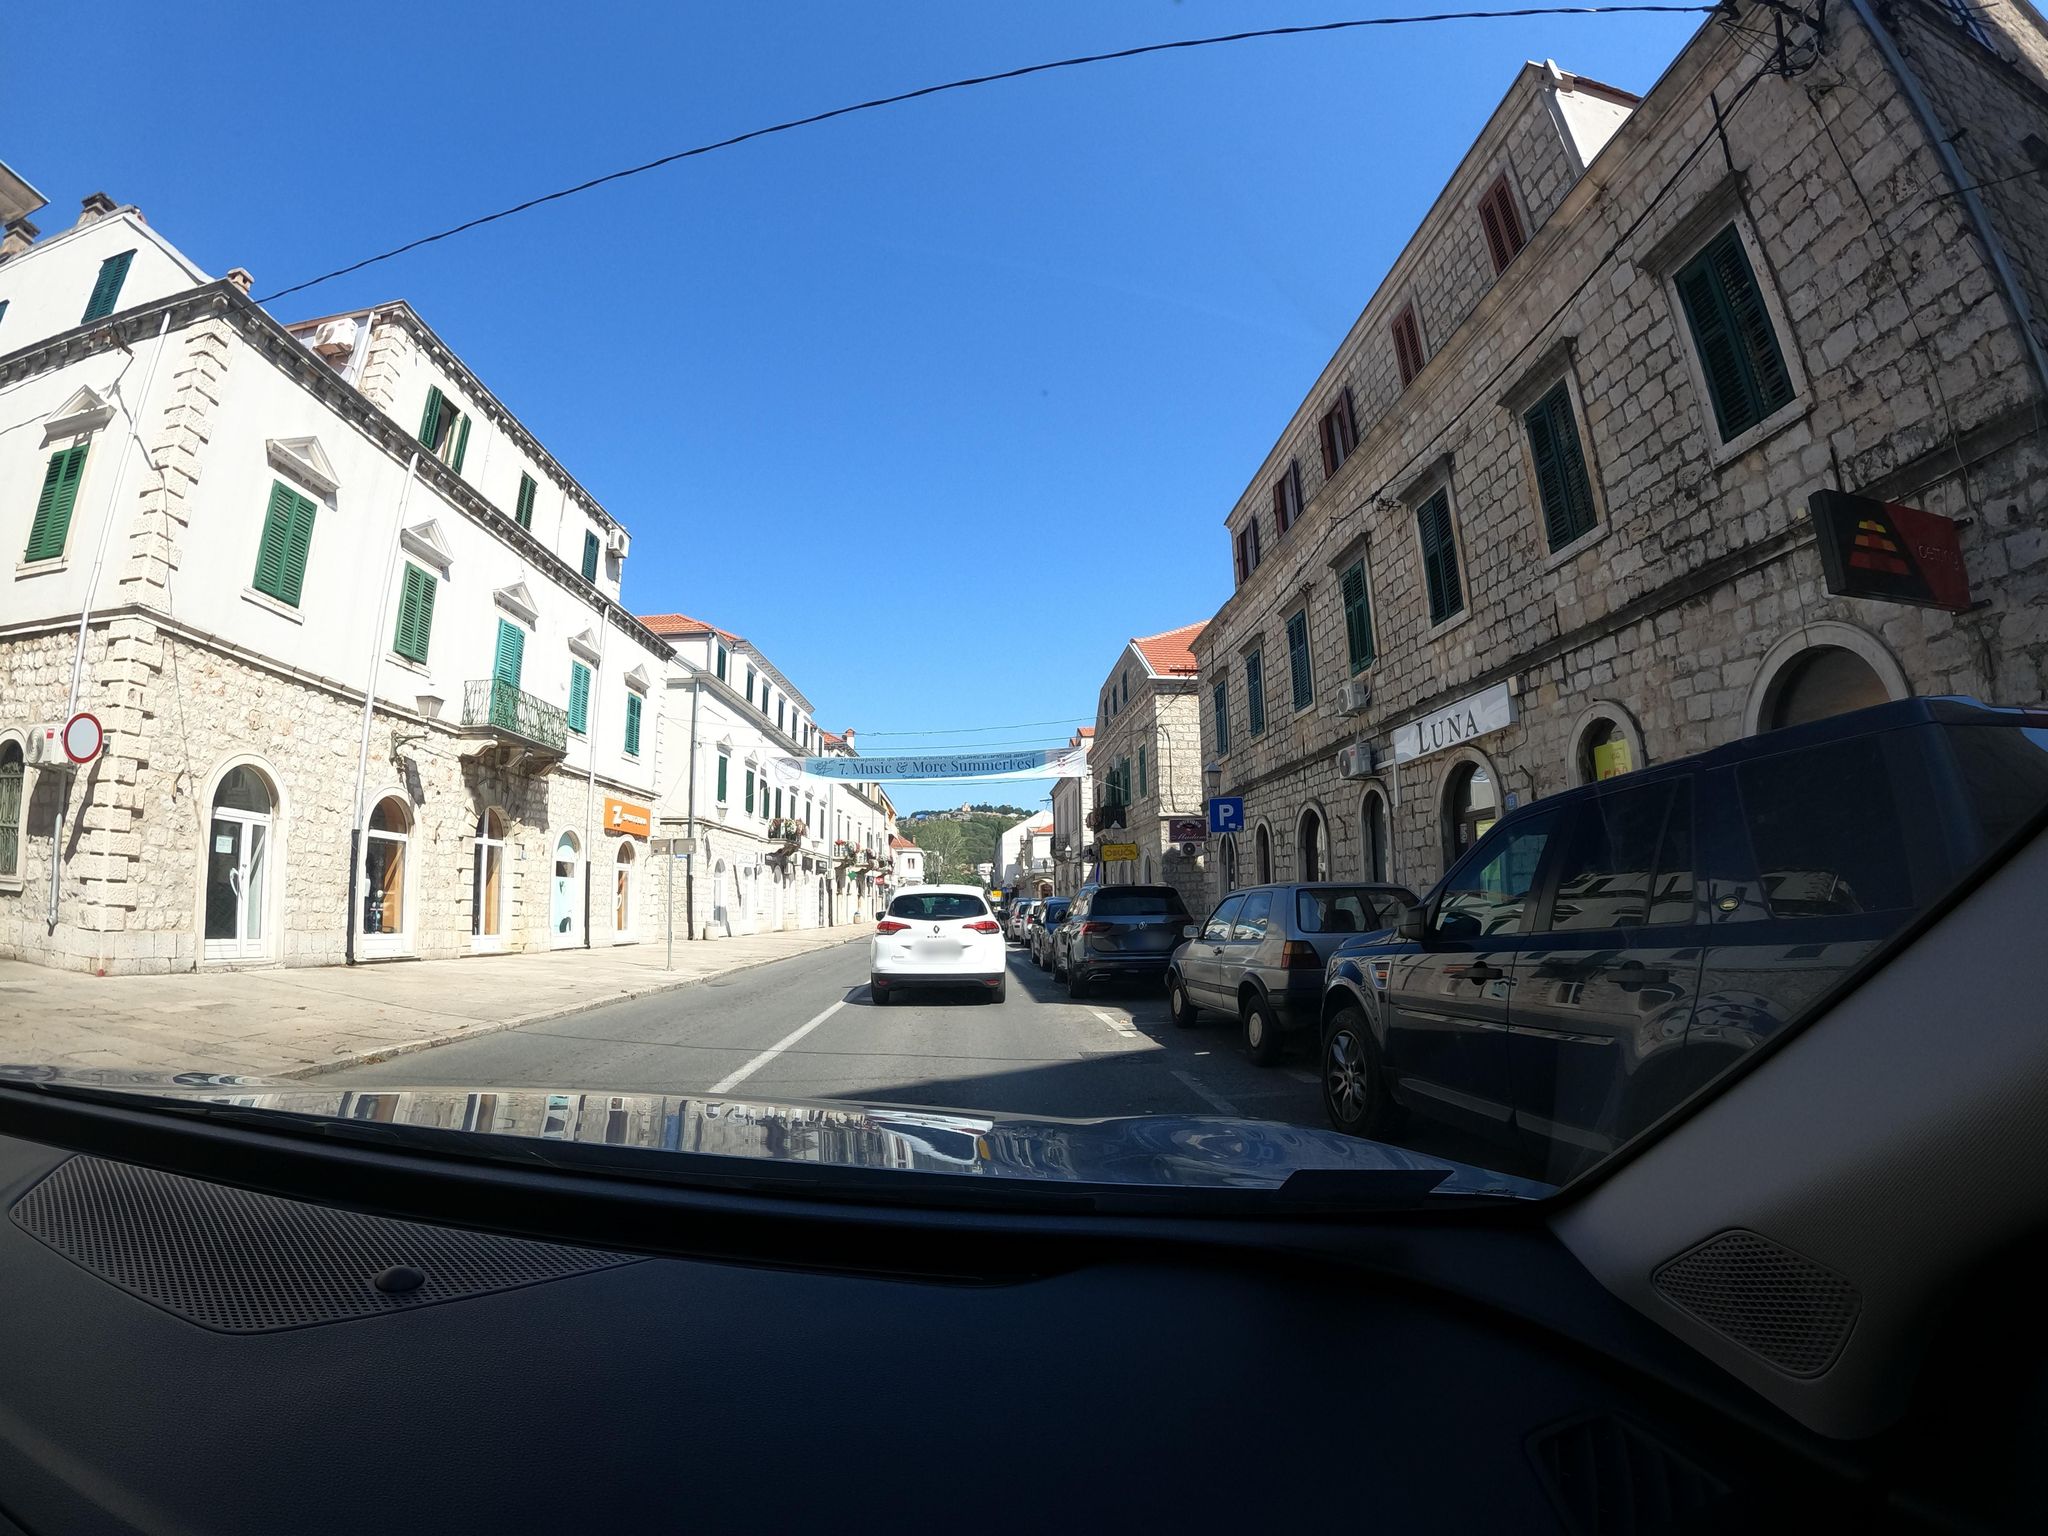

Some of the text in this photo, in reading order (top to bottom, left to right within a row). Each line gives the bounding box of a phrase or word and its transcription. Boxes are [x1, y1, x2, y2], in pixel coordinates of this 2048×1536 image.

[1416, 709, 1479, 755] LUNA
[839, 763, 848, 775] 7.
[853, 762, 892, 775] Music
[896, 762, 908, 773] &
[913, 760, 947, 773] More
[951, 757, 1035, 773] SummerFest
[1218, 804, 1234, 826] P
